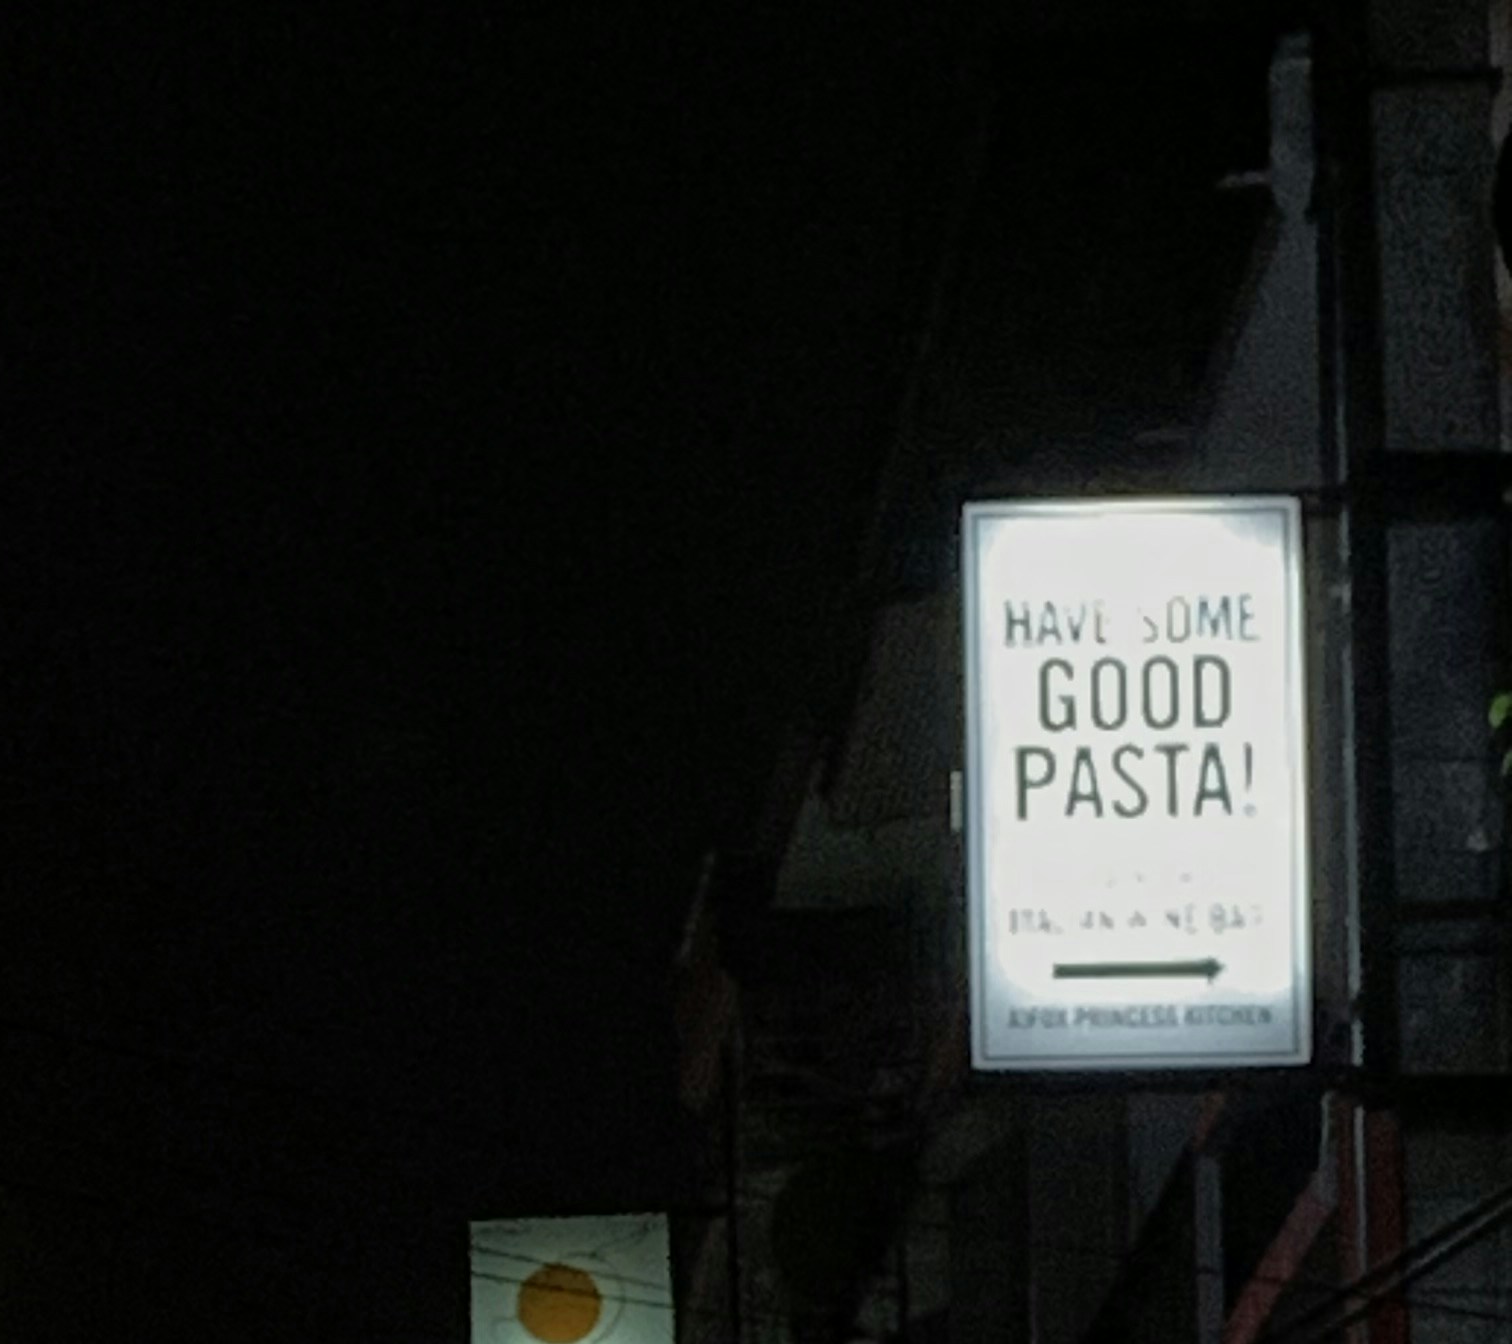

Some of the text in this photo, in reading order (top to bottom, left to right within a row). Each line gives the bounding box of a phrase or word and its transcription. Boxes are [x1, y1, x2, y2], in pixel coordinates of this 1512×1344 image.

[1003, 598, 1108, 648] HAVE
[1037, 654, 1232, 733] GOOD
[1013, 741, 1258, 822] PASTA!
